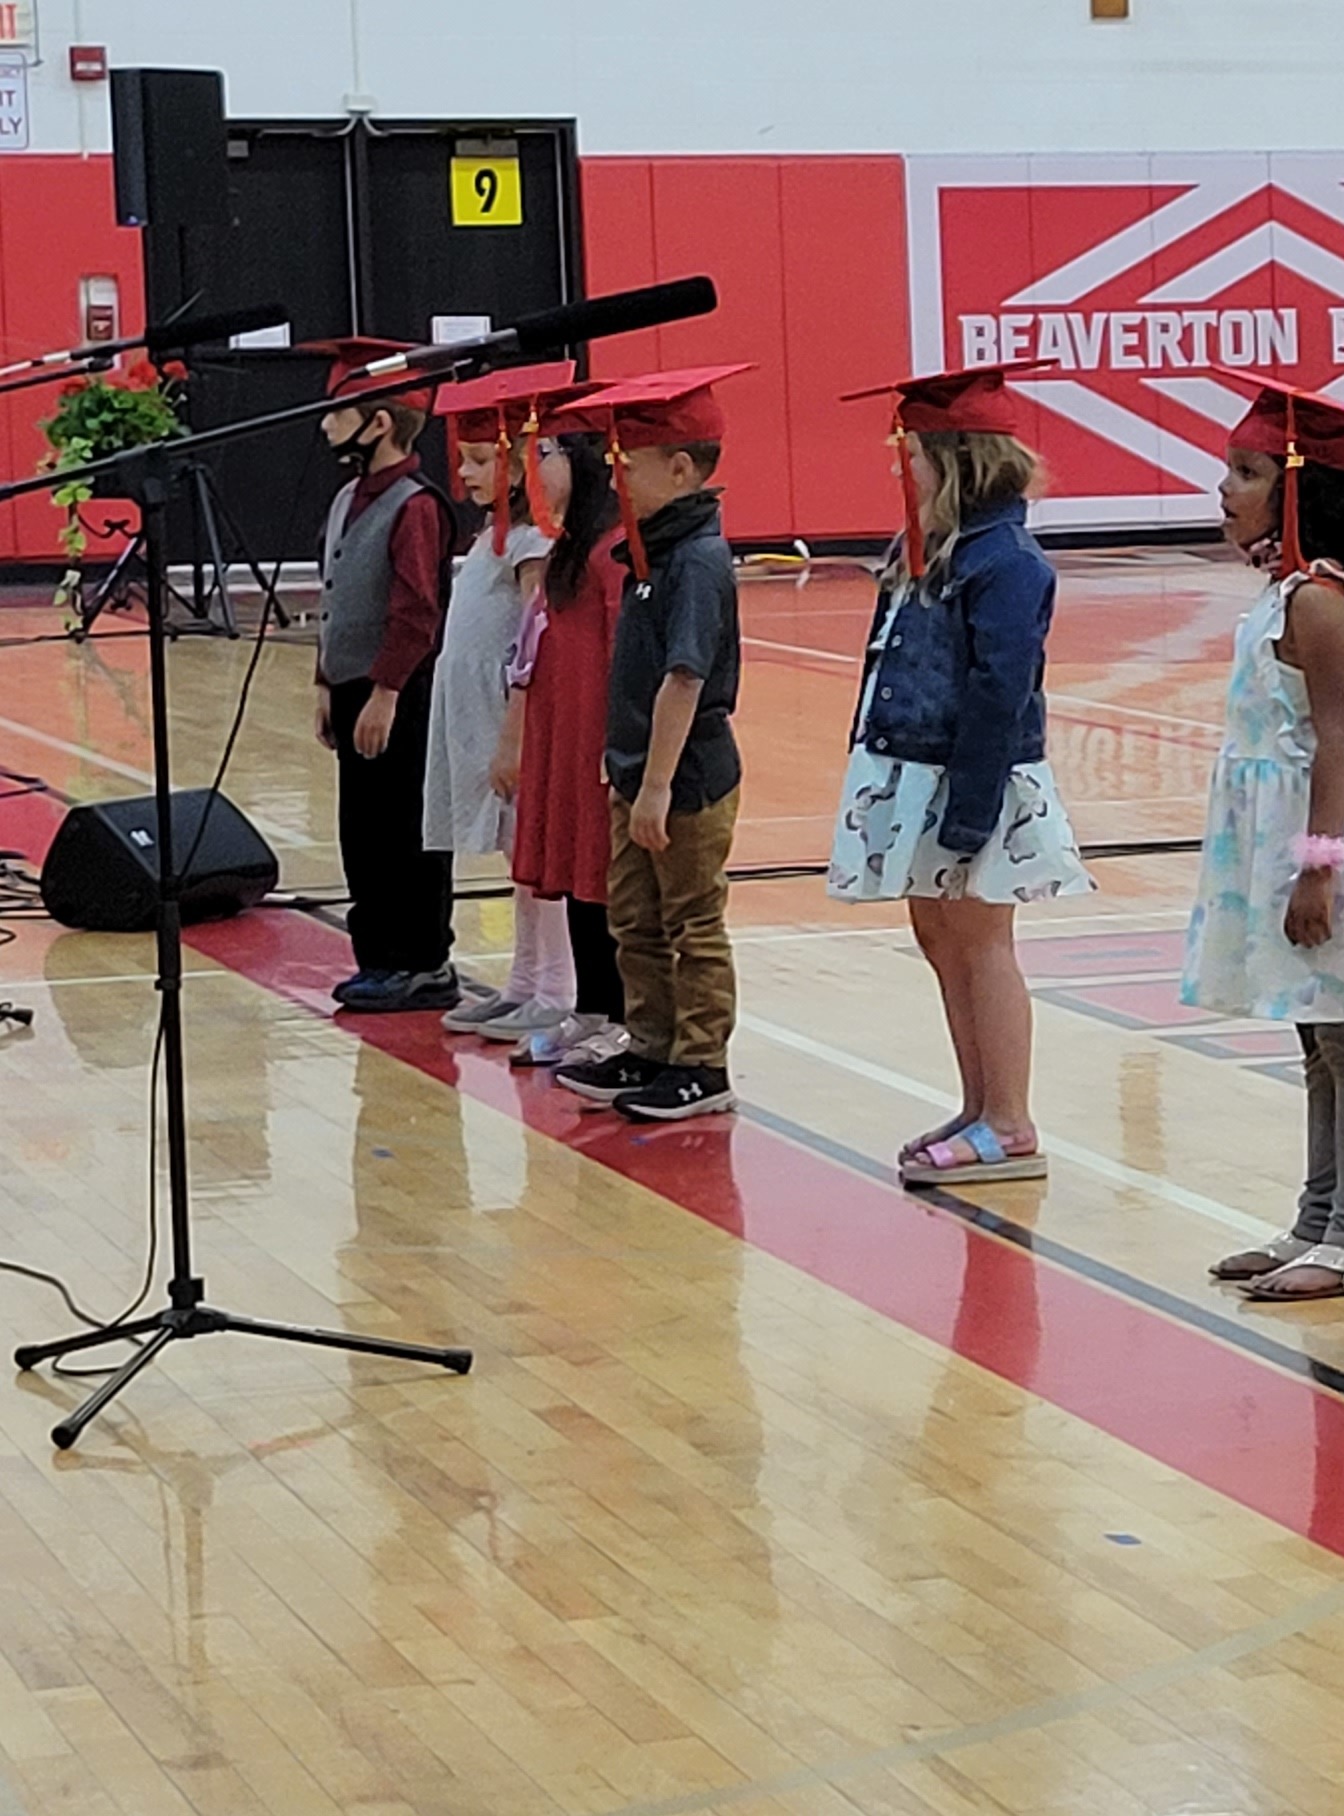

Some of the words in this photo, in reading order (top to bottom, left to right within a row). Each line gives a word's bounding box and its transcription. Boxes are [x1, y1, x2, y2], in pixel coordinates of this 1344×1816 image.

[0, 117, 22, 135] LY
[475, 168, 498, 213] 9
[958, 308, 1298, 370] BEAVERTON
